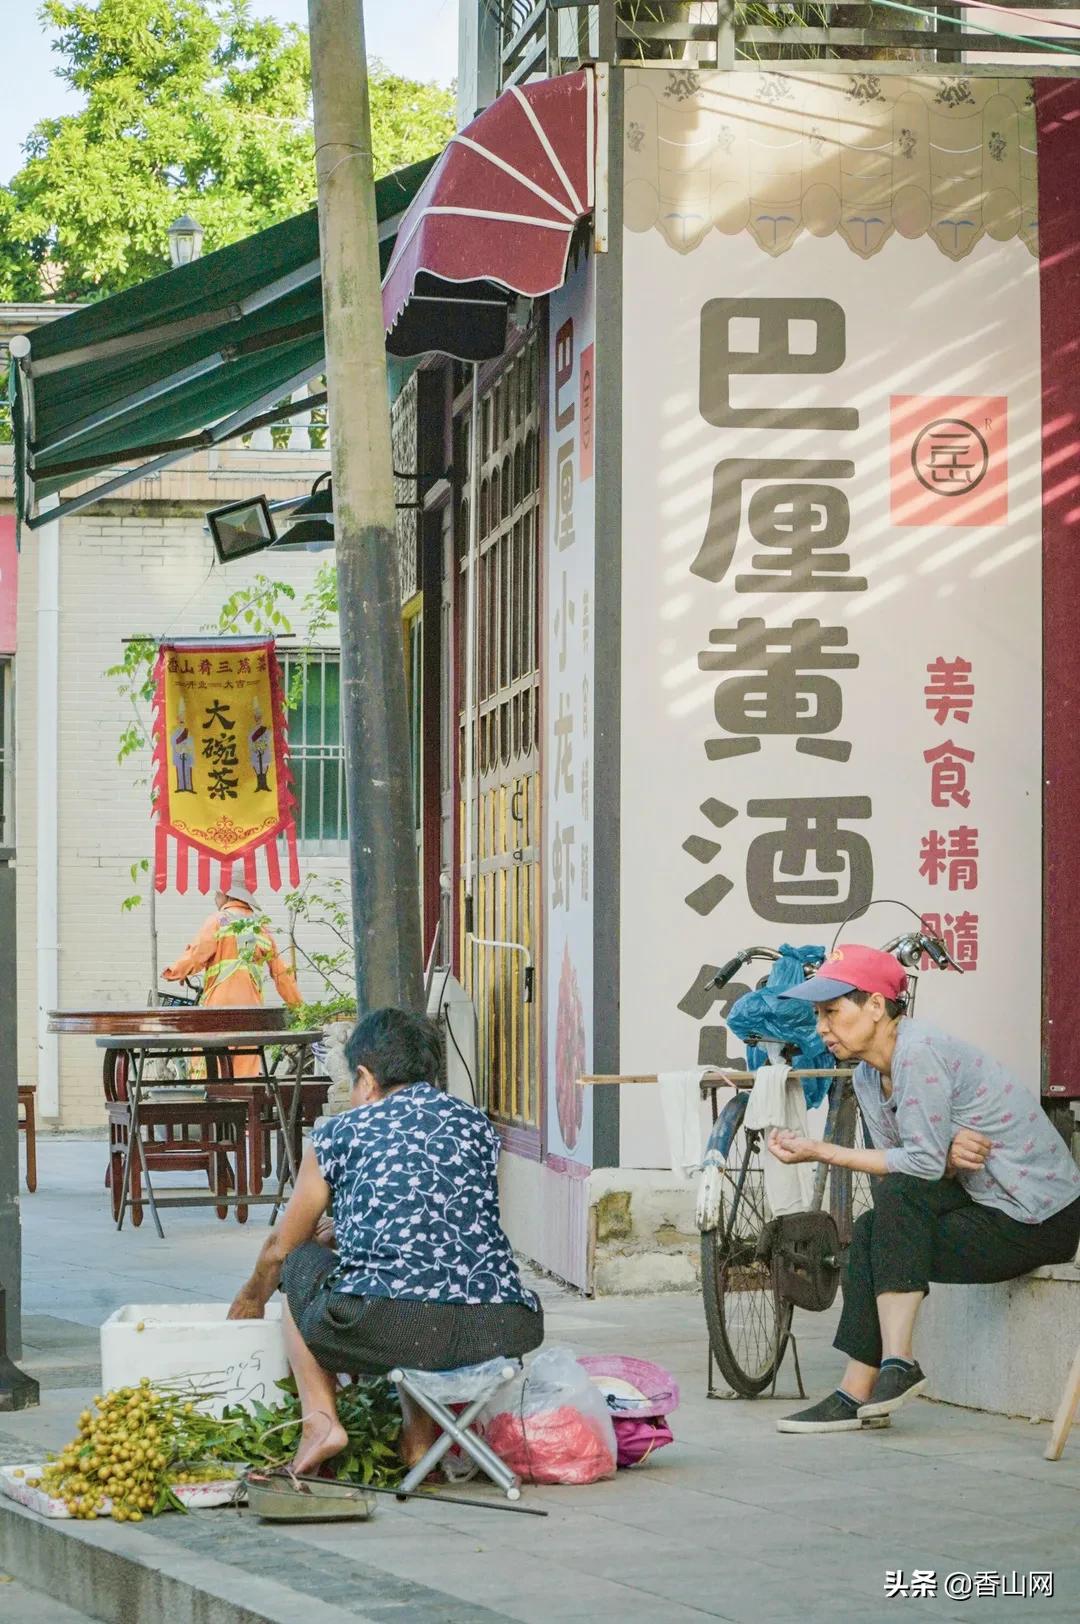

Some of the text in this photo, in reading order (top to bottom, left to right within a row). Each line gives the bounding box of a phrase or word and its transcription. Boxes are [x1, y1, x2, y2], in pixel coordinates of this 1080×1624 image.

[201, 698, 240, 801] 大碗茶
[552, 316, 576, 913] 巴厘小龙虾
